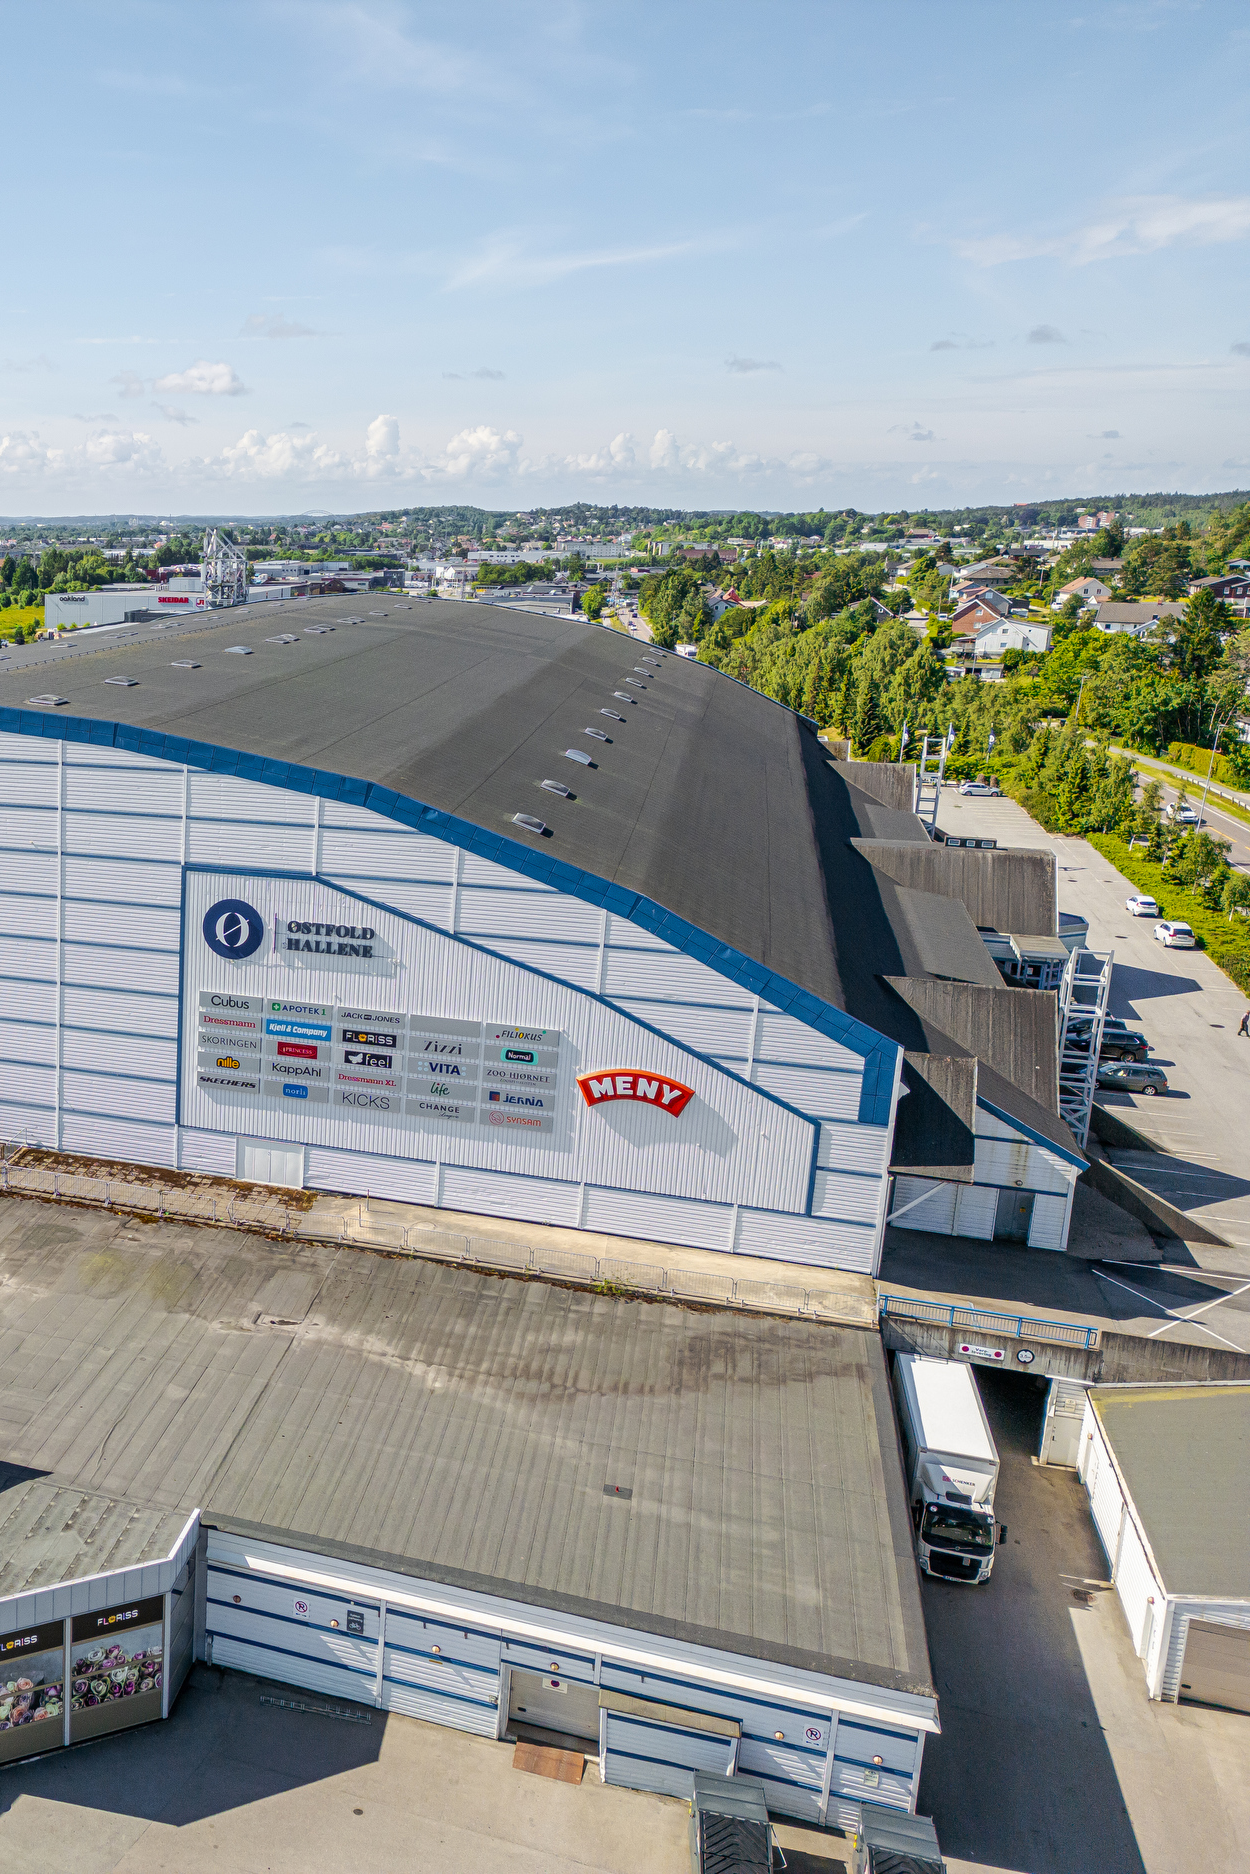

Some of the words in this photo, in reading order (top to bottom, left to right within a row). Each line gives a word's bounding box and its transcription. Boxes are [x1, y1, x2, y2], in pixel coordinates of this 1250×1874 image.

[287, 920, 375, 940] ØSTFOLD
[287, 938, 373, 958] HALLENE
[211, 995, 250, 1009] Cubus
[282, 1005, 320, 1015] APOTEK
[203, 1016, 256, 1028] Dressmann
[341, 1012, 363, 1020] JACK
[372, 1015, 400, 1024] JONES
[269, 1023, 286, 1032] Kjell
[292, 1026, 327, 1037] Company
[202, 1035, 257, 1049] SKORINGEN
[424, 1041, 462, 1055] Zizzi
[217, 1056, 240, 1069] nille
[365, 1054, 390, 1068] feel
[508, 1051, 532, 1061] Normal
[272, 1062, 321, 1077] KappAhl
[429, 1062, 461, 1076] VITA
[200, 1076, 256, 1089] SKECHERS
[338, 1073, 384, 1086] Dressmann
[285, 1088, 306, 1096] norli
[430, 1082, 450, 1096] life
[588, 1076, 682, 1105] MENY
[342, 1092, 390, 1109] KICKS
[419, 1102, 460, 1114] CHANGE
[952, 1478, 976, 1487] SCHENKER
[97, 1609, 139, 1627] FLORISS
